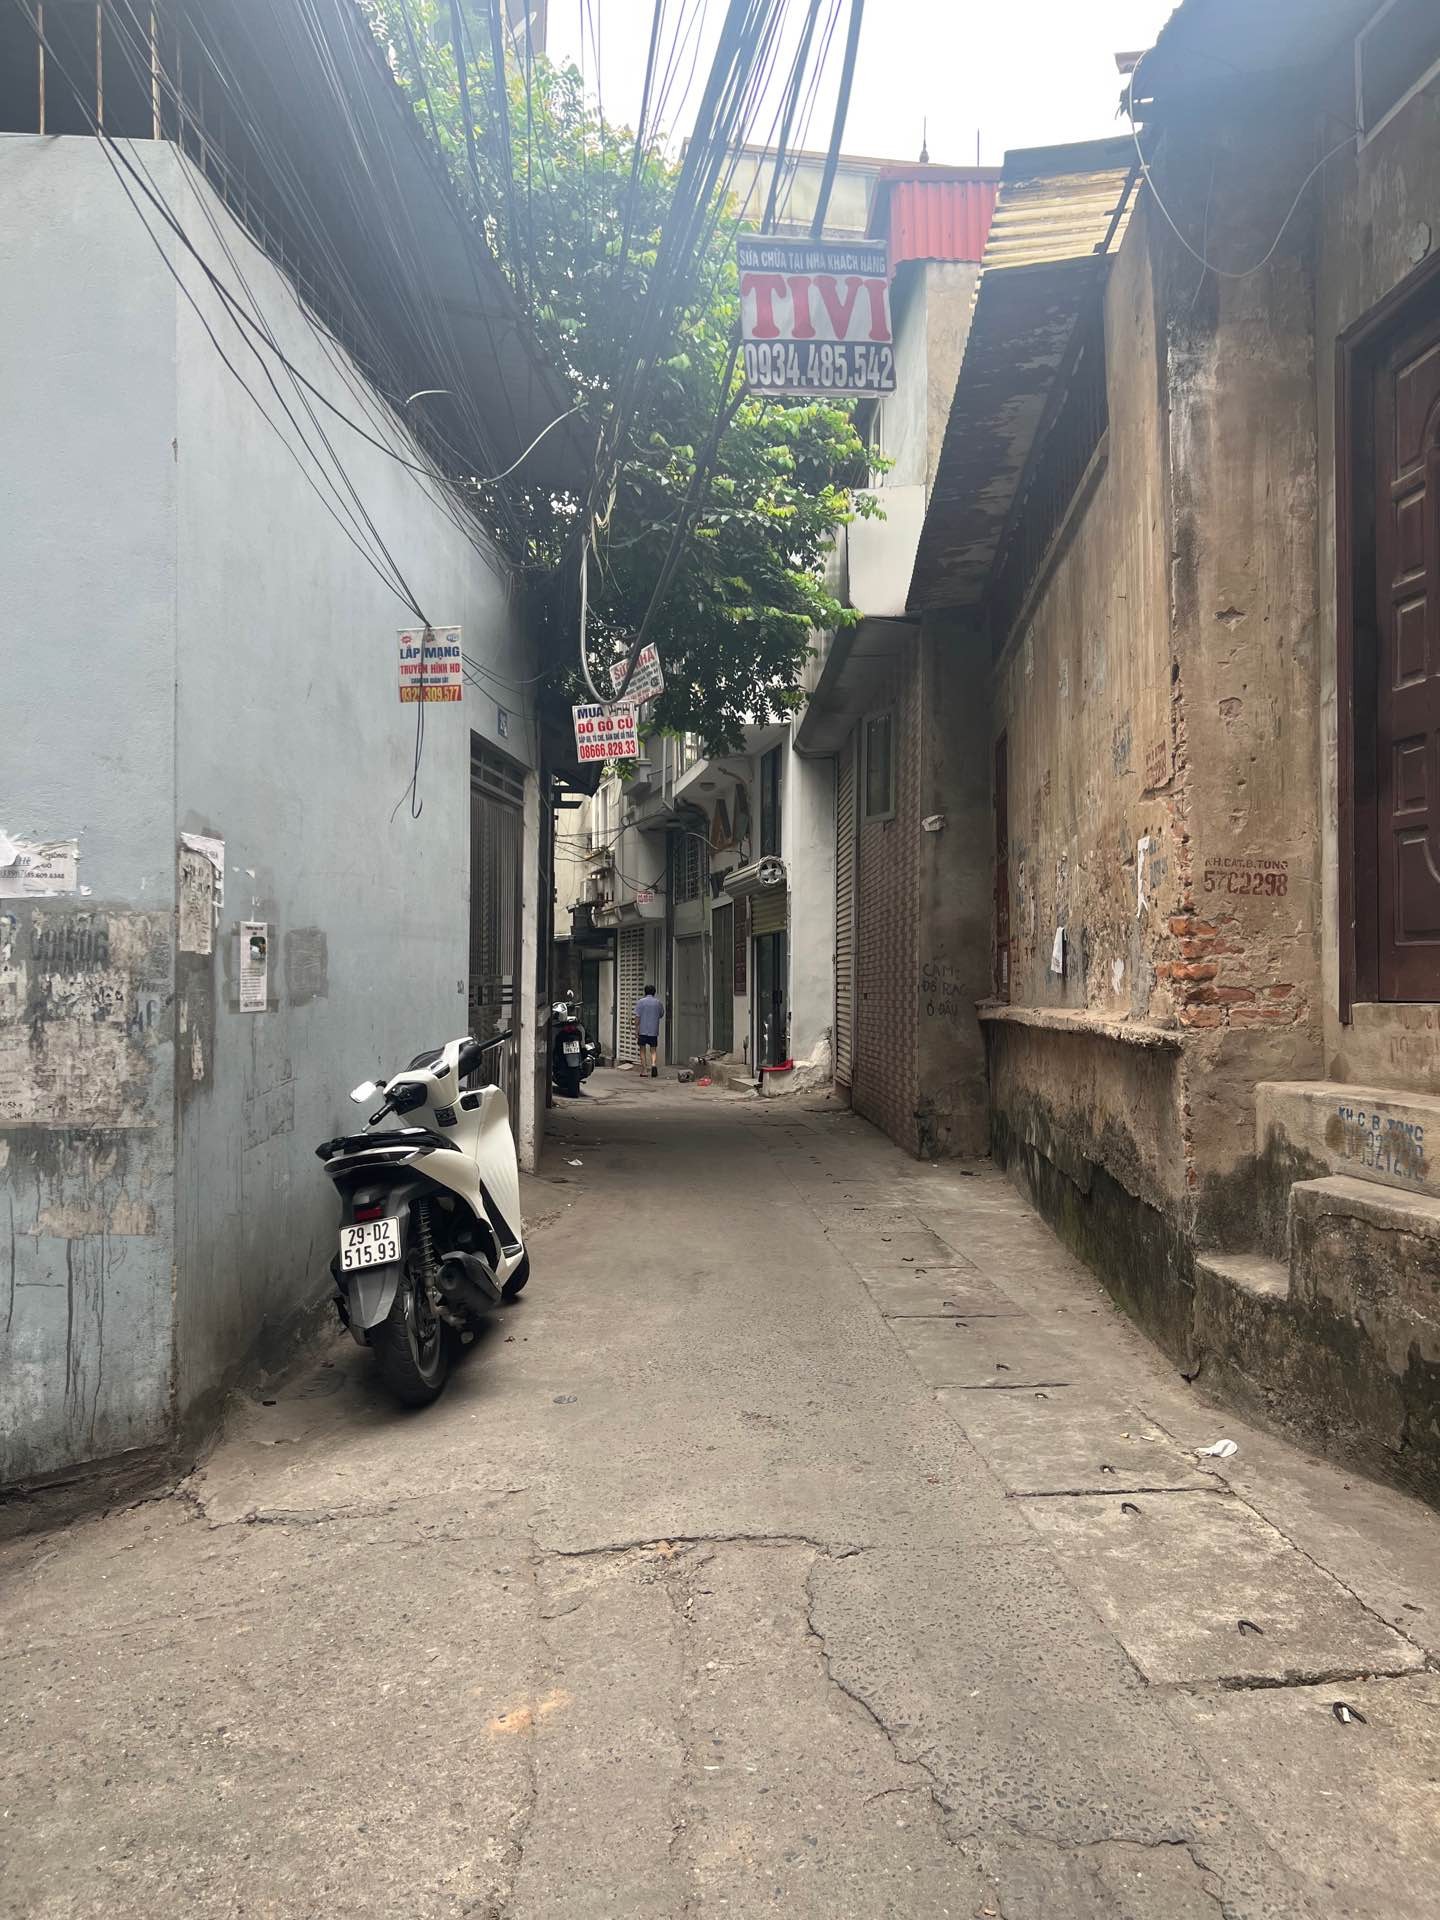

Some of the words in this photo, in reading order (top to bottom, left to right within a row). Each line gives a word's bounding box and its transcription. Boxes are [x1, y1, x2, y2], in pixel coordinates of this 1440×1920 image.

[741, 273, 892, 342] TIVI
[745, 343, 894, 389] 0934.485.542
[425, 646, 461, 661] MẠNG
[577, 706, 604, 720] MUA
[580, 740, 636, 760] 08666.828.33
[348, 1222, 390, 1247] 29-D2
[344, 1241, 396, 1268] 515.93
